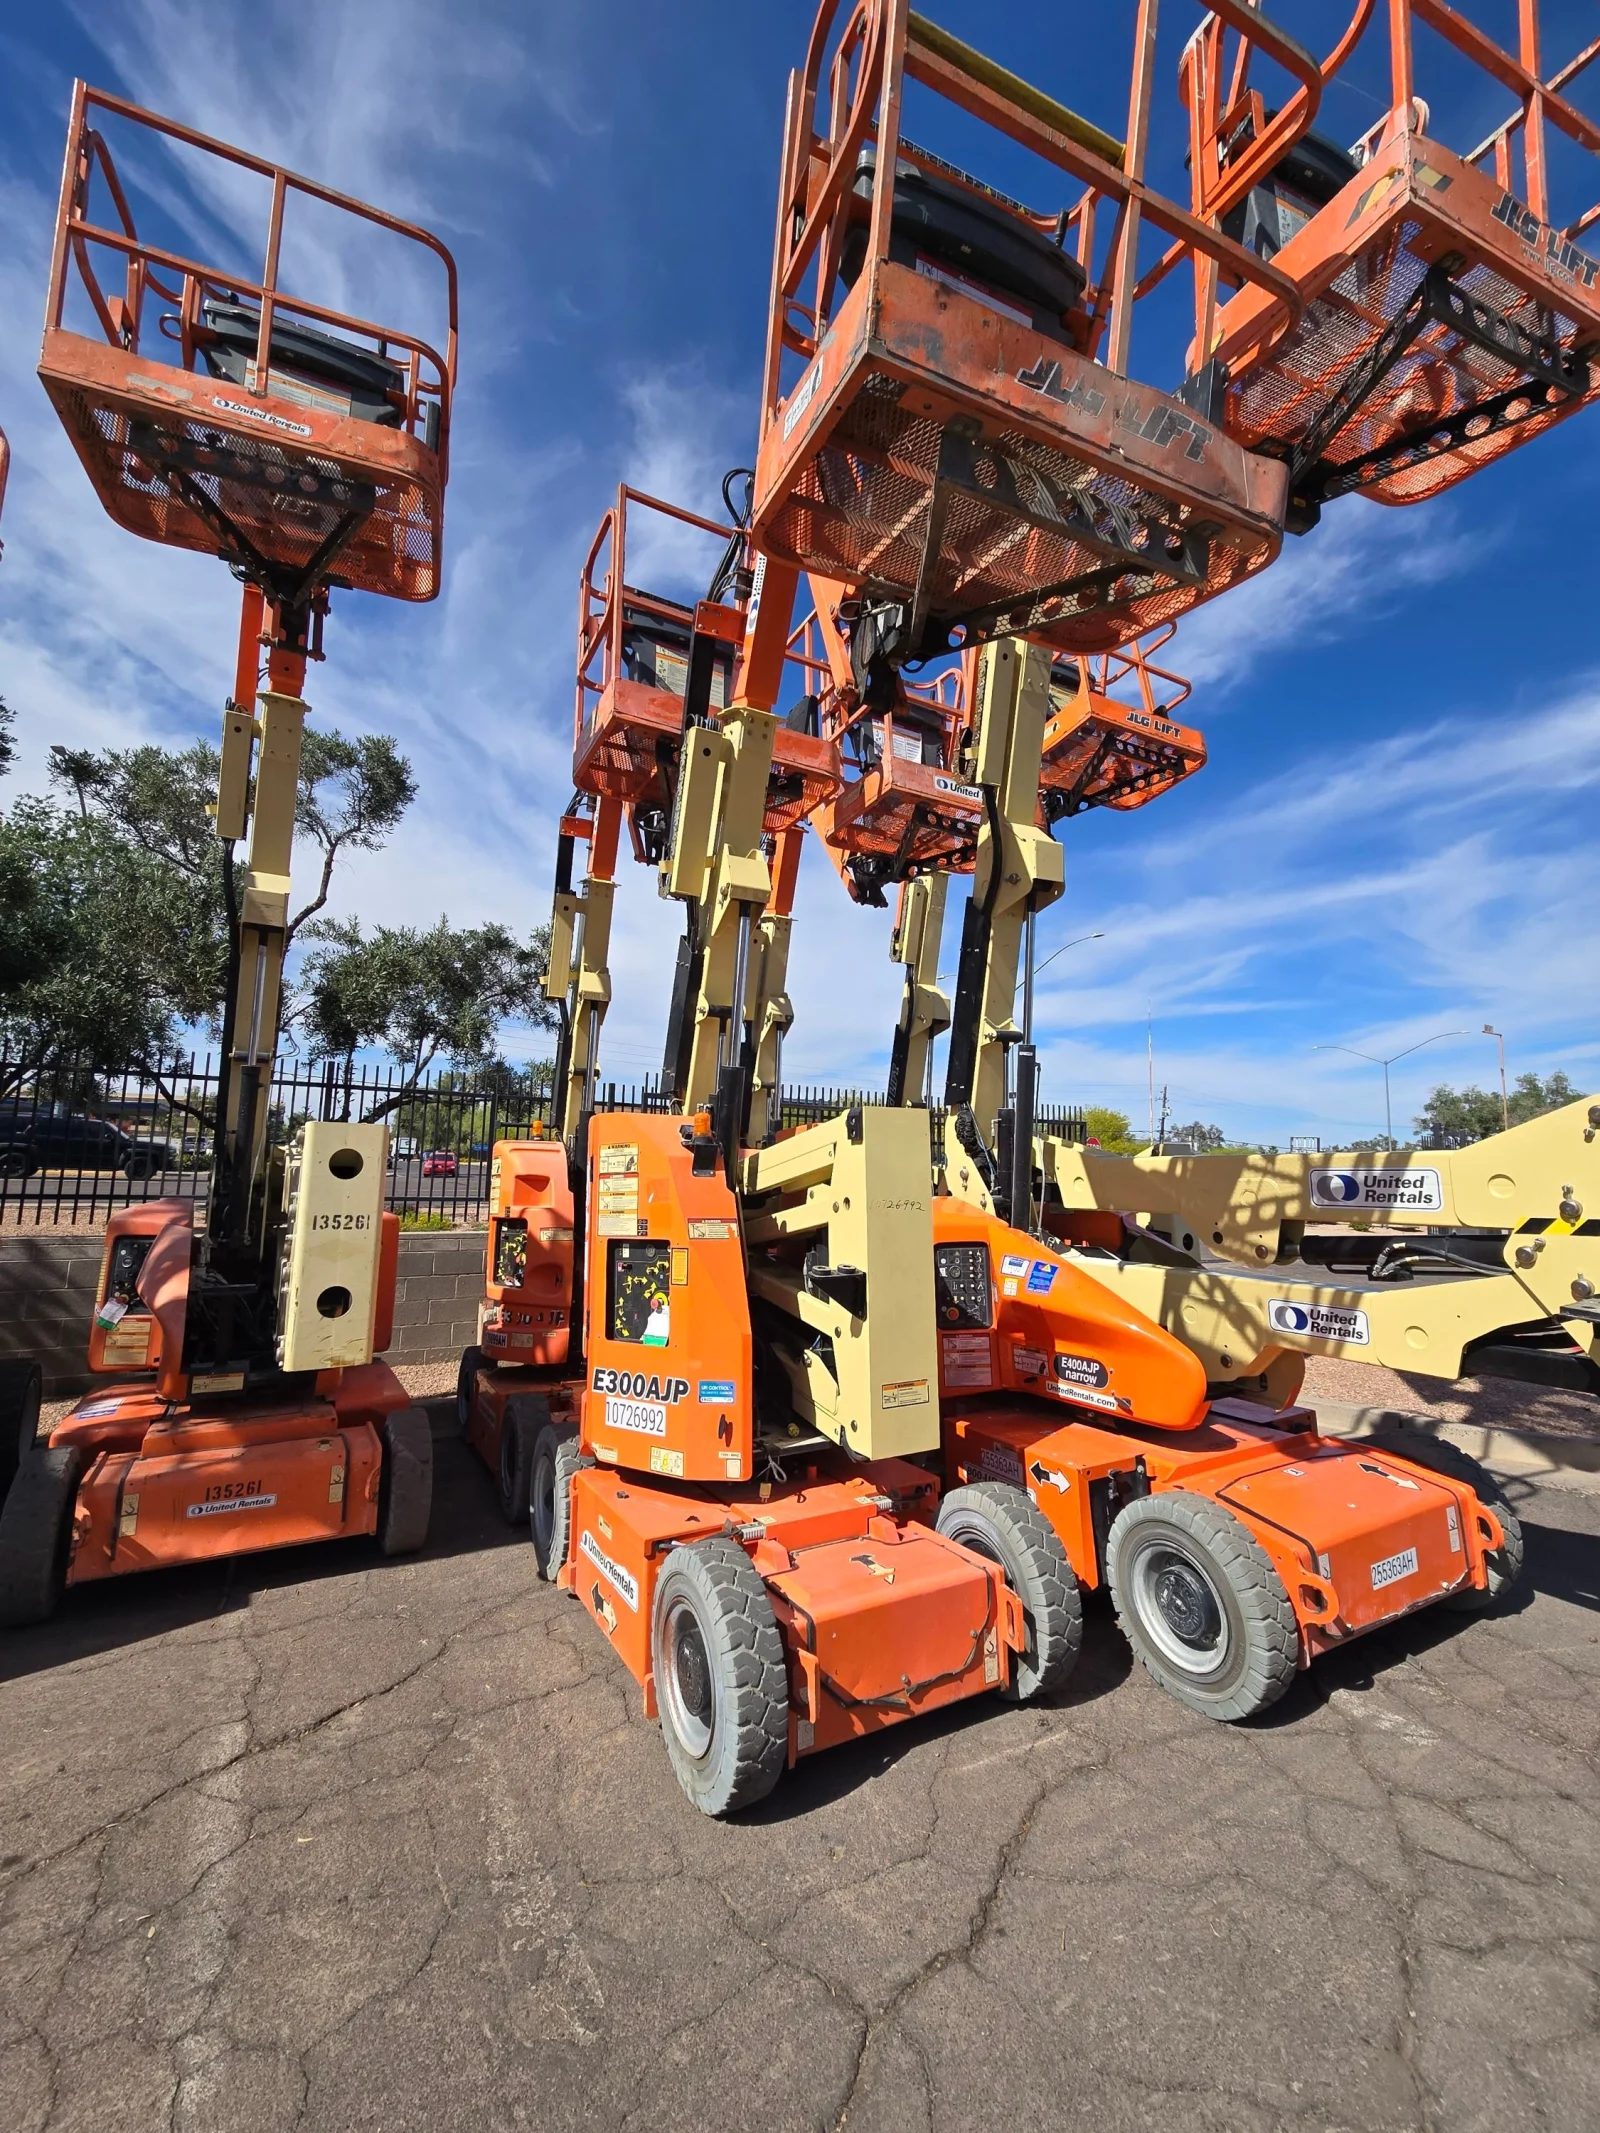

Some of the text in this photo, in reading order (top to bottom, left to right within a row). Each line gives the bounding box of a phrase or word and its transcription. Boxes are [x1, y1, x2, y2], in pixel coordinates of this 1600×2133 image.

[1490, 192, 1600, 290] JLG LIFT
[230, 403, 306, 433] United Rentals
[1115, 391, 1215, 465] LIFT
[1126, 711, 1181, 739] JLG LIFT
[950, 782, 980, 798] United
[1363, 1175, 1425, 1189] United
[1364, 1189, 1434, 1204] Rentals
[312, 1214, 371, 1231] 135261
[1309, 1308, 1358, 1327] United
[1310, 1321, 1364, 1340] Rentals
[1061, 1356, 1100, 1374] E400AJP
[592, 1367, 690, 1404] E300AJP
[1065, 1370, 1098, 1385] narrow
[1047, 1383, 1115, 1408] UnitedRentals.com
[606, 1401, 664, 1433] 10726992
[981, 1449, 1021, 1478] 255363AH
[205, 1479, 263, 1502] 135261
[204, 1497, 273, 1513] United Rentals
[1371, 1551, 1414, 1586] 255363AH
